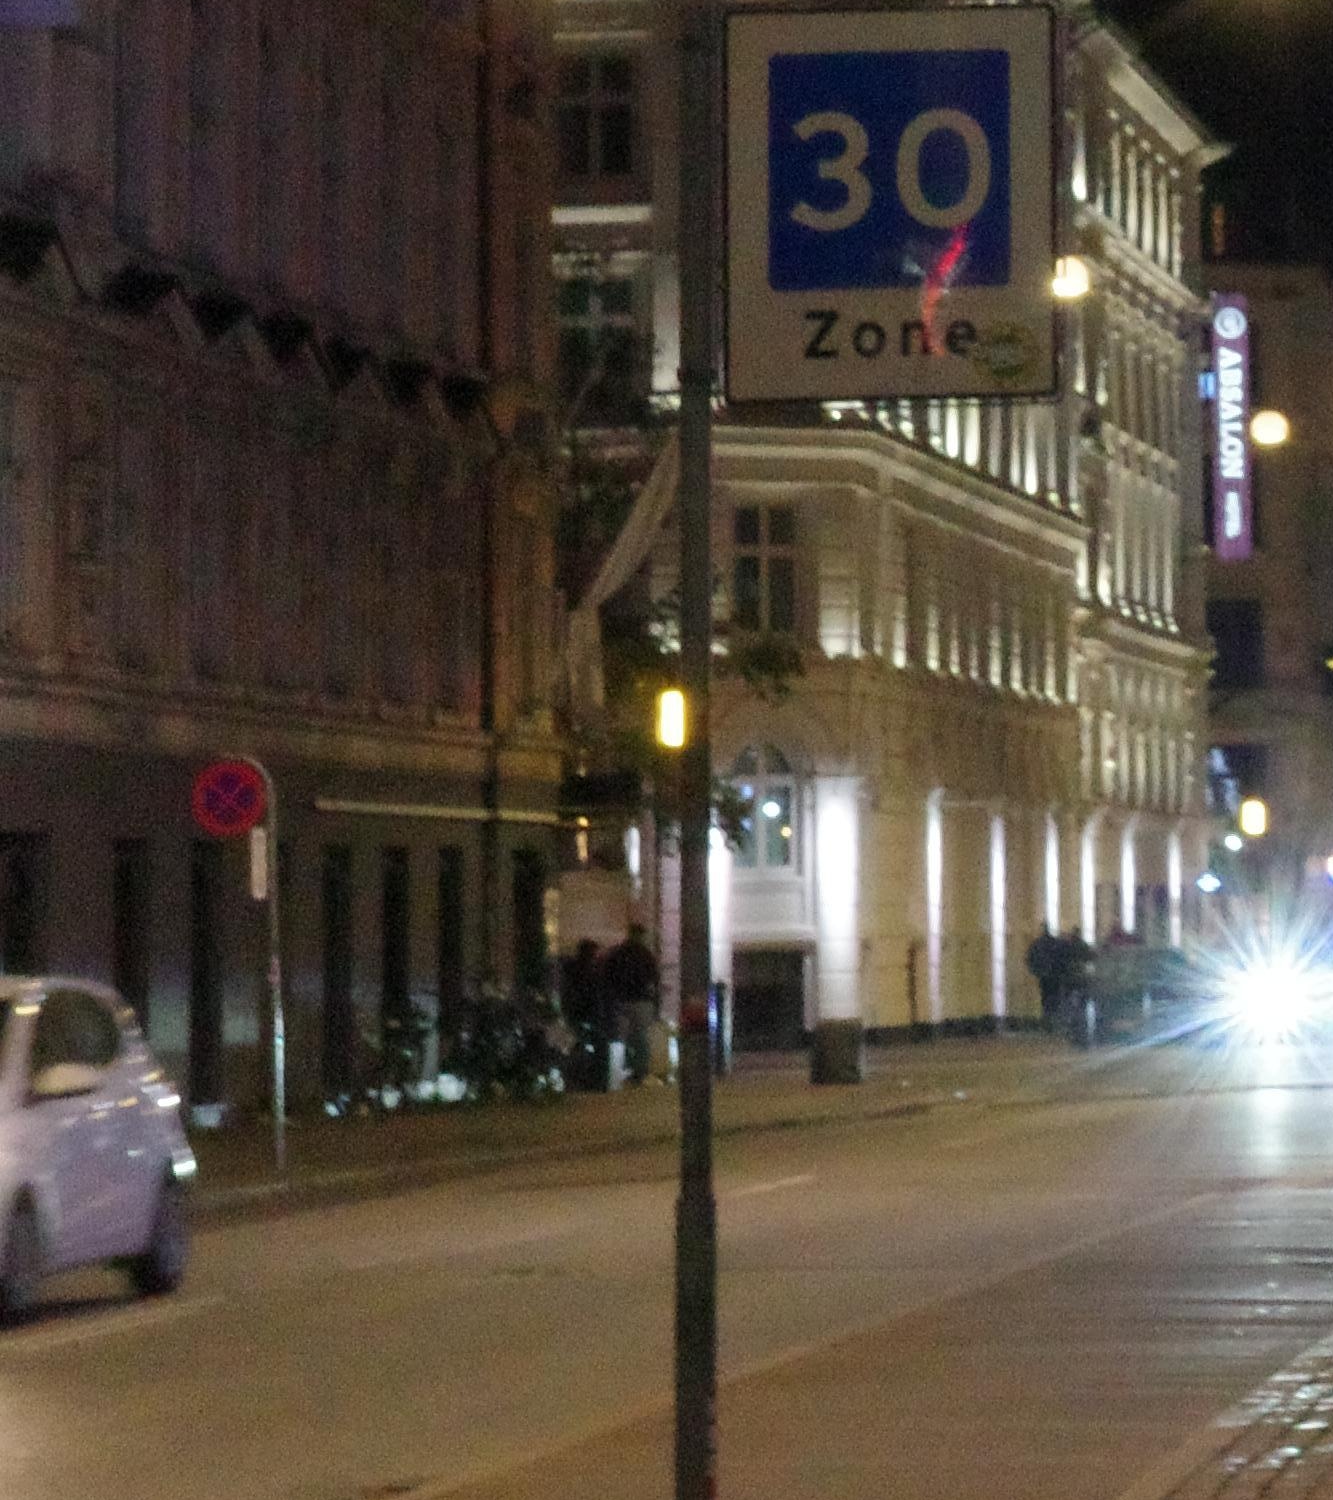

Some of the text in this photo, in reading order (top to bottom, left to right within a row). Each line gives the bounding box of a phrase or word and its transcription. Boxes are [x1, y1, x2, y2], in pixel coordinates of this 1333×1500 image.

[791, 108, 992, 232] 30
[805, 310, 978, 360] Zone
[1217, 346, 1245, 479] ABSALON
